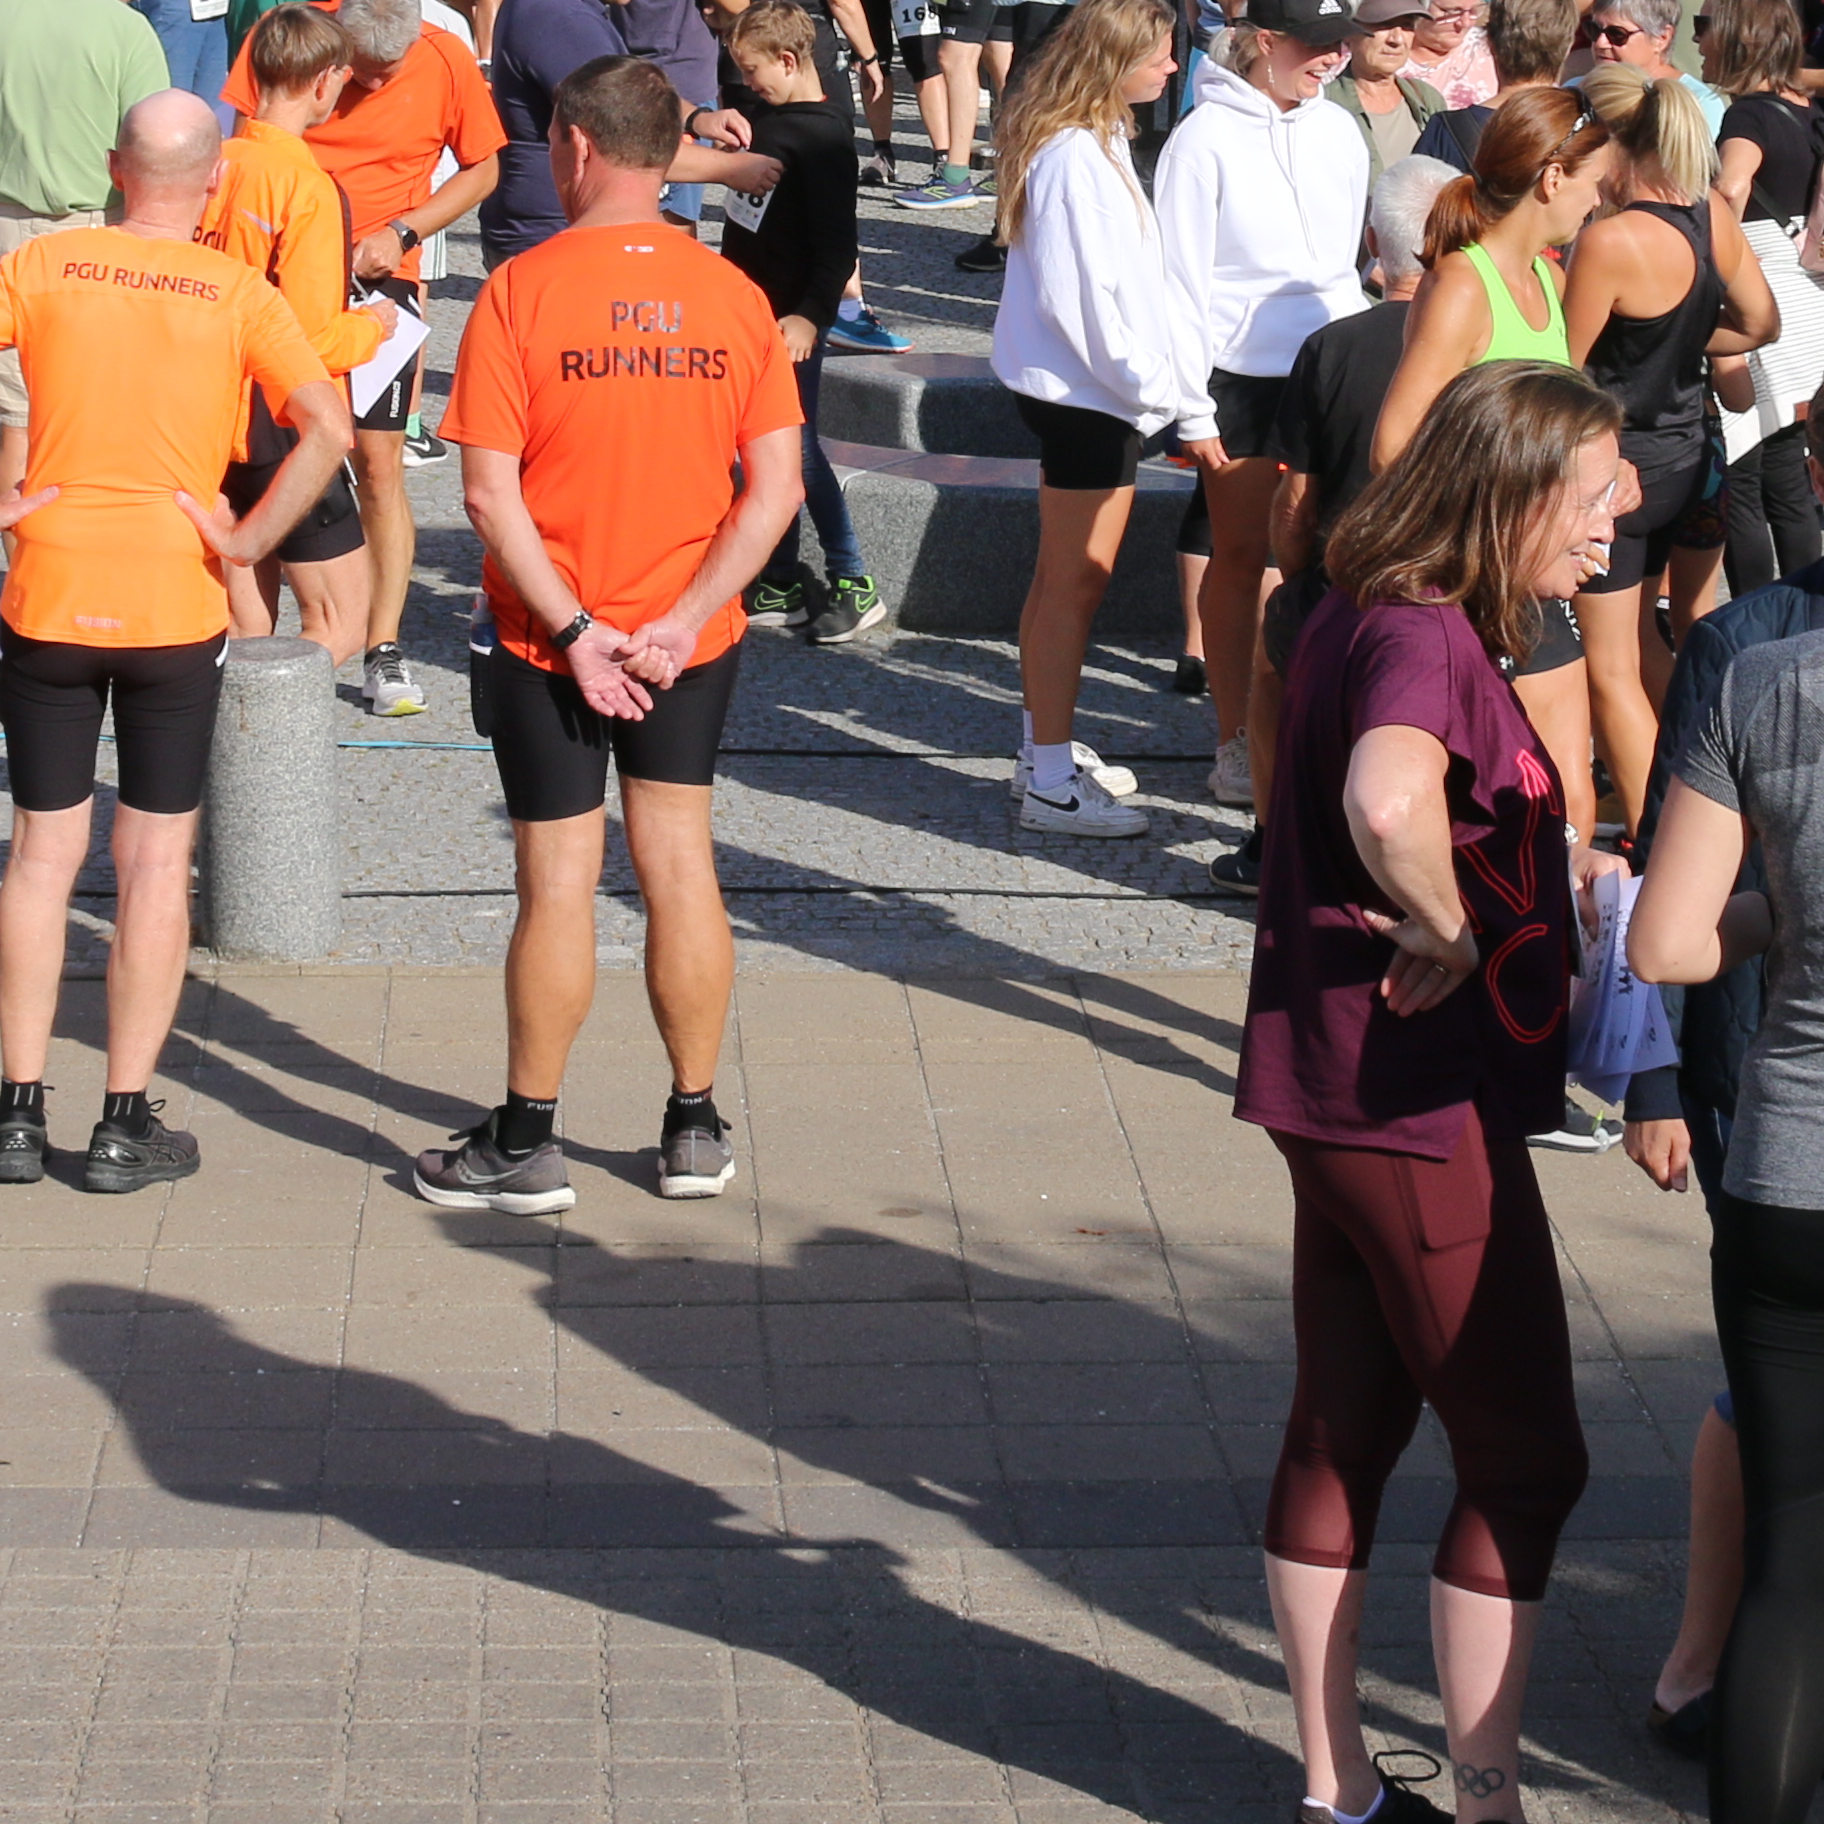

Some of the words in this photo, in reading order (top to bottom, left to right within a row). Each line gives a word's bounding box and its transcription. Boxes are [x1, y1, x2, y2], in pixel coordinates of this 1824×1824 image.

[62, 262, 109, 282] PGU
[112, 267, 221, 303] RUNNERS
[610, 300, 682, 334] PGU
[560, 345, 728, 382] RUNNERS
